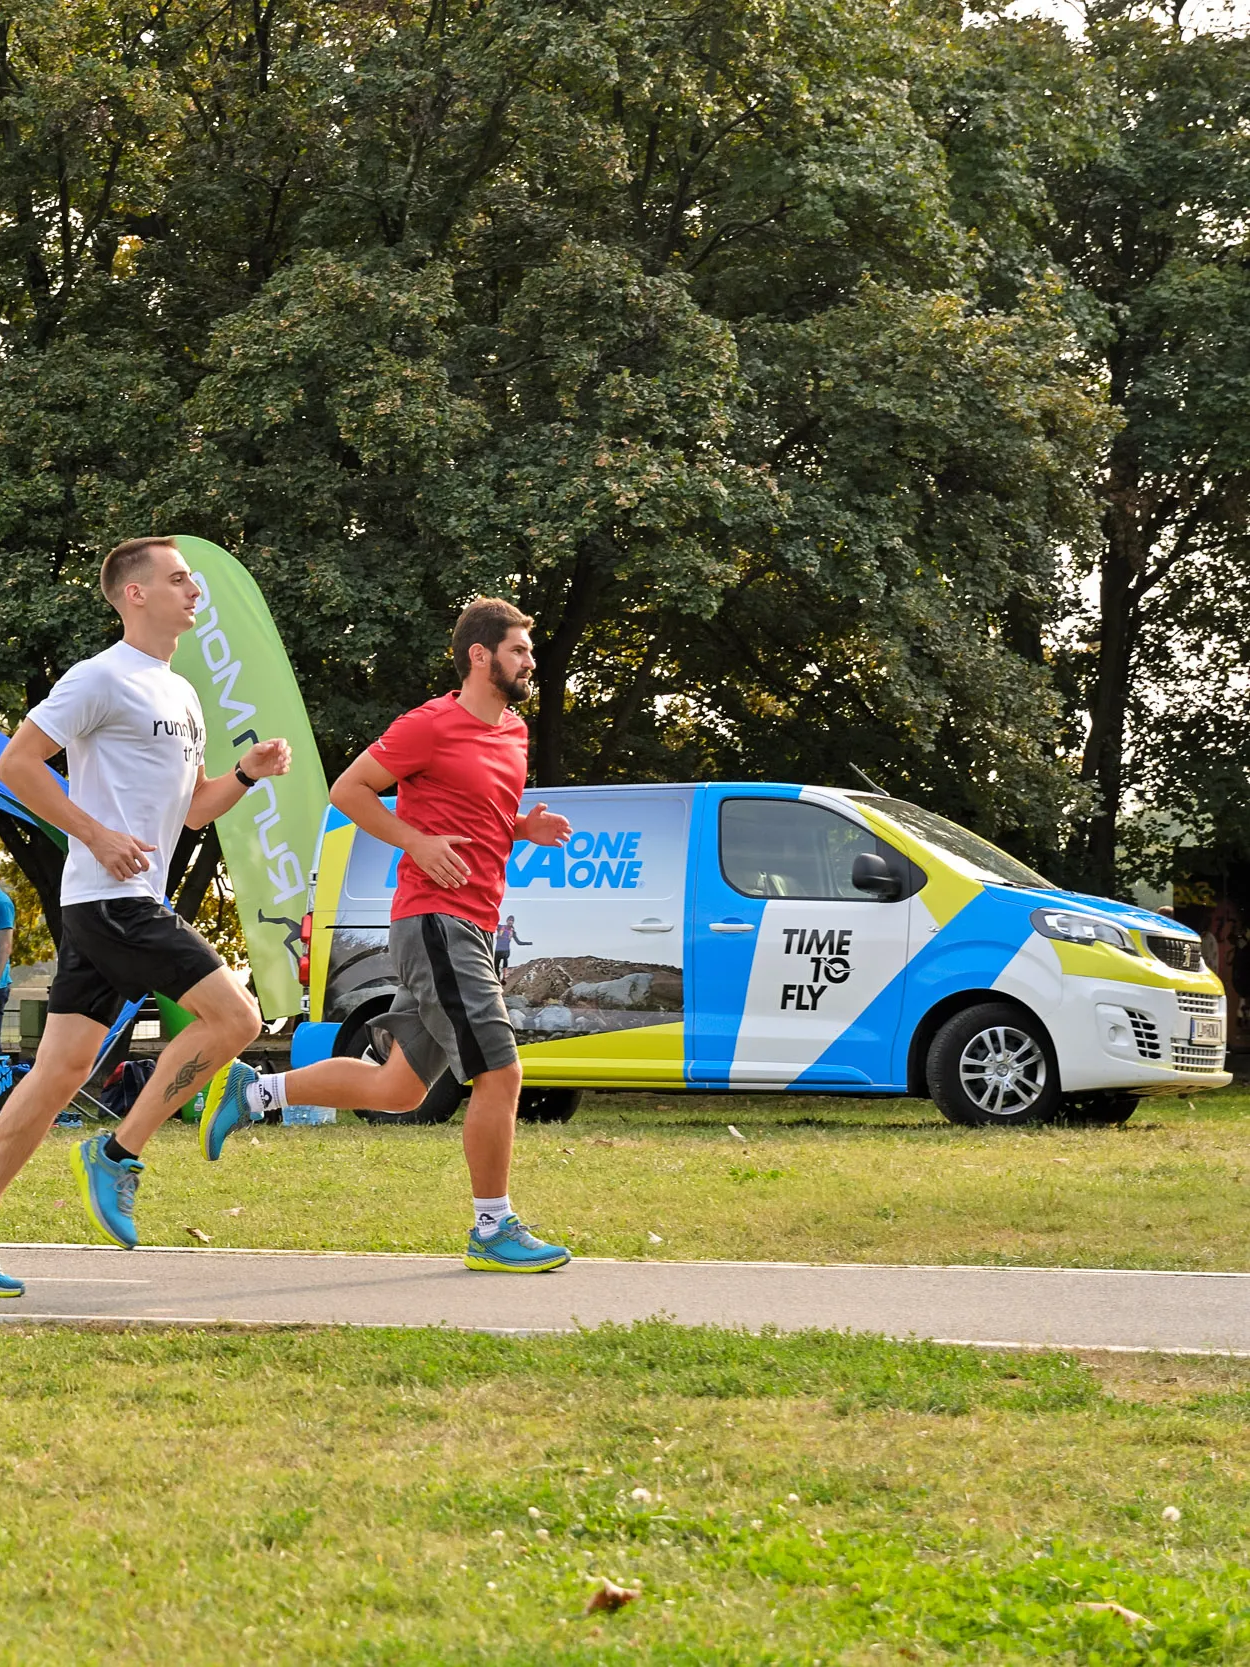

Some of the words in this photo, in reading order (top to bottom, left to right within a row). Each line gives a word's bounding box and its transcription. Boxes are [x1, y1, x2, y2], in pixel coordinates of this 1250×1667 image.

[566, 831, 642, 859] ONE
[567, 860, 643, 889] ONE
[782, 928, 853, 955] TIME
[810, 956, 851, 984] TO
[780, 984, 828, 1011] FLY
